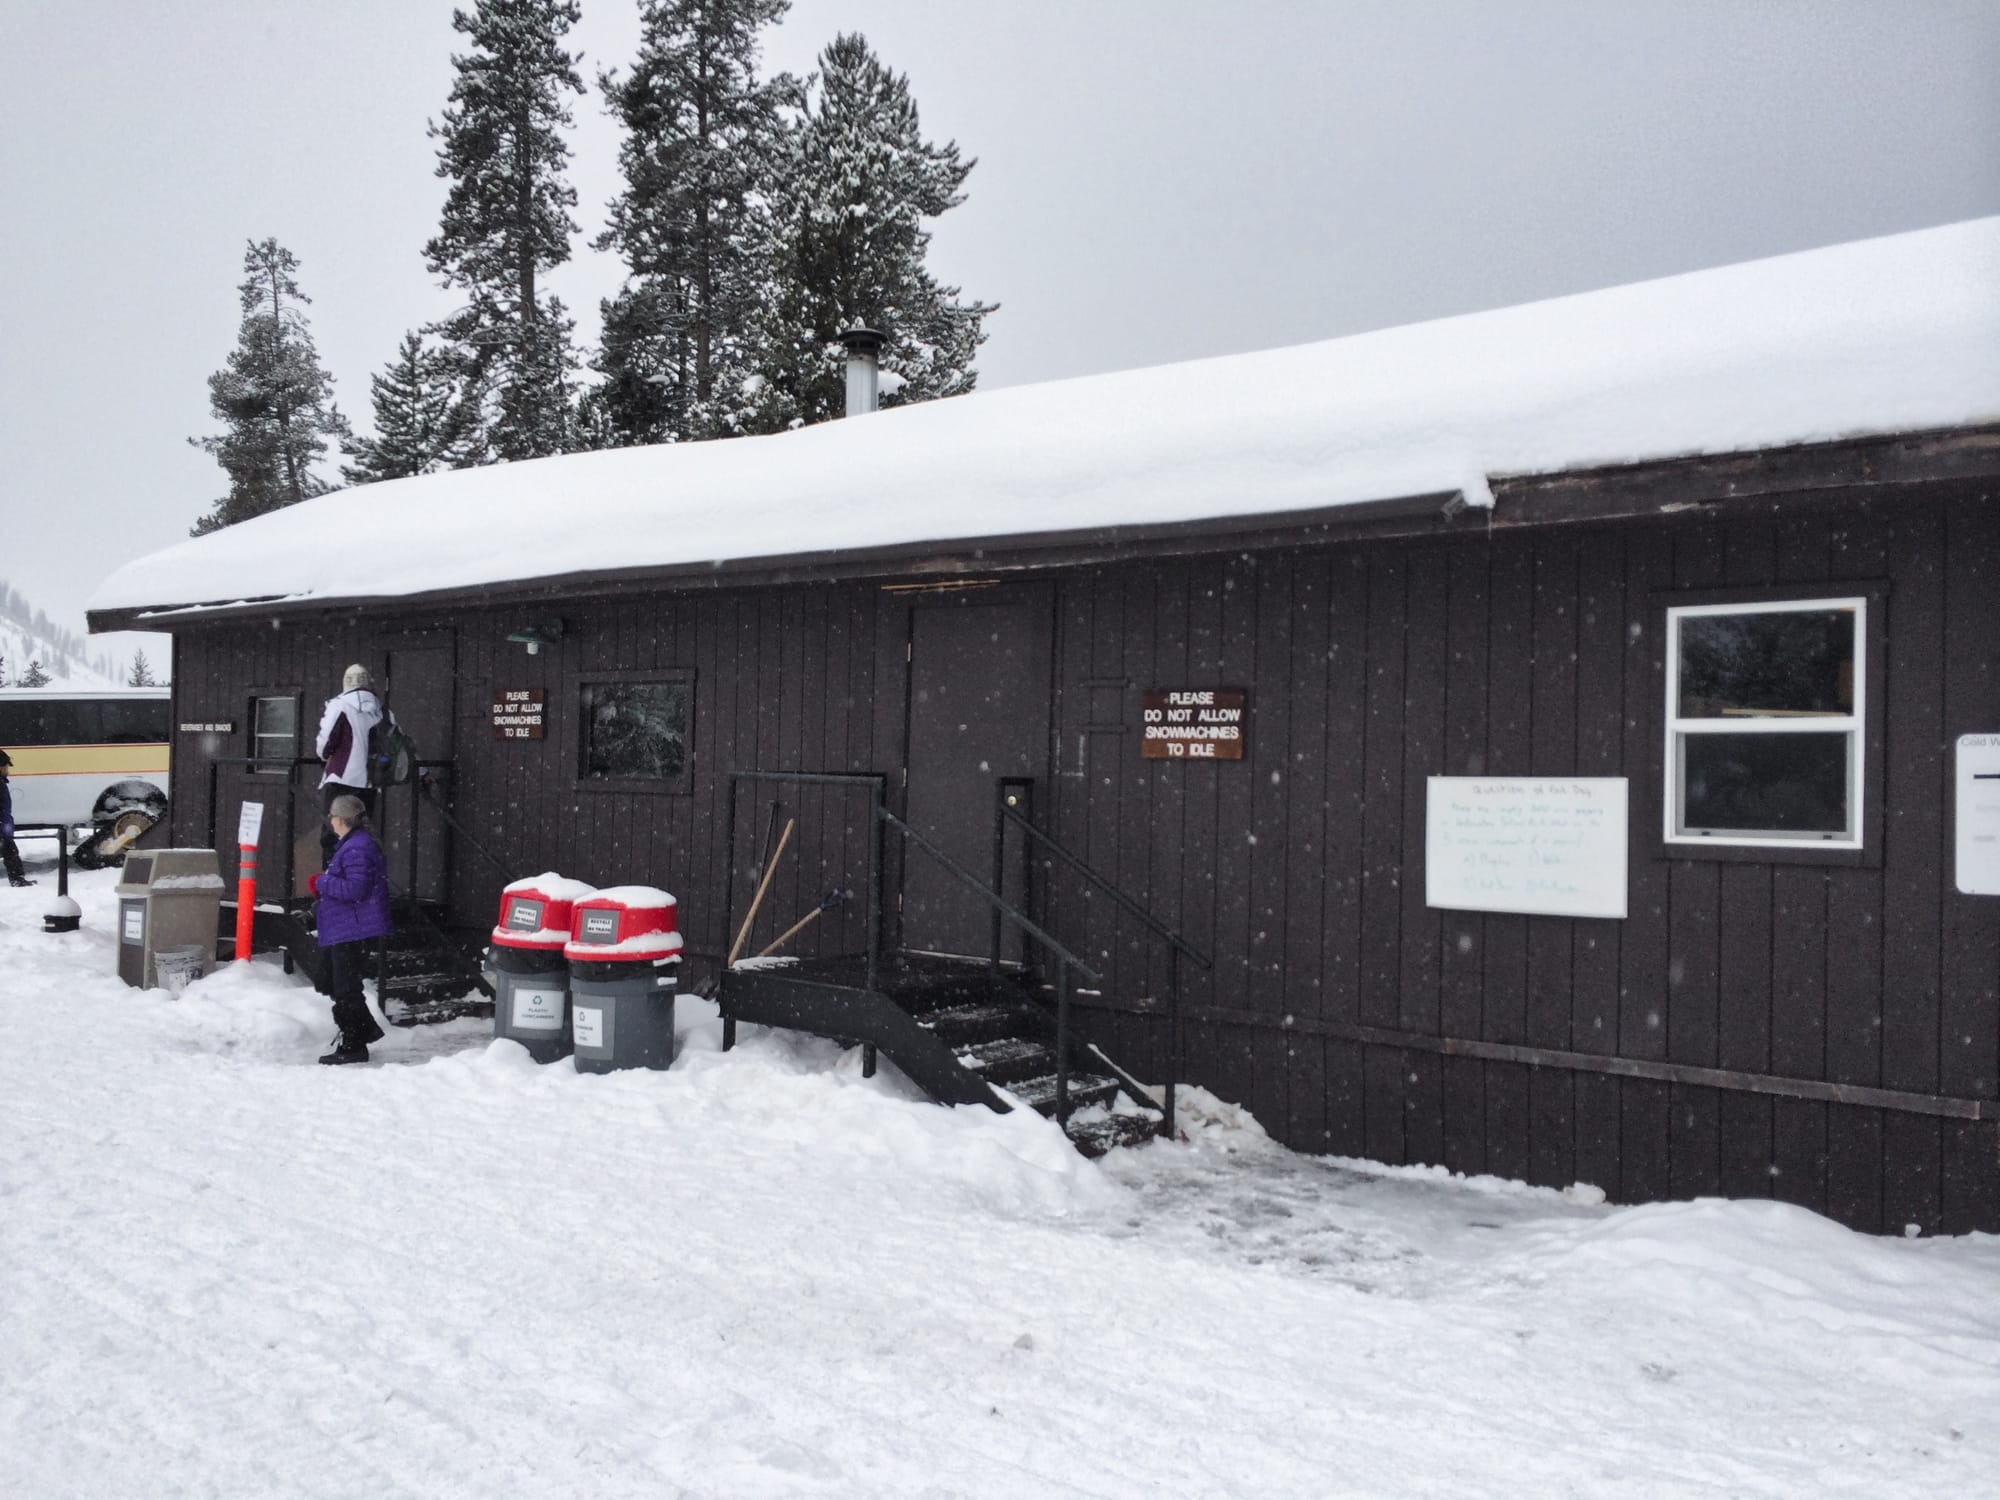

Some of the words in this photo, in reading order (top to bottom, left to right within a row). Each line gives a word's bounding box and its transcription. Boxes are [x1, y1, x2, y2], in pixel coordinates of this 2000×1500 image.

[506, 691, 530, 701] PLEASE
[1169, 691, 1214, 705] PLEASE
[493, 703, 504, 713] DO
[505, 703, 518, 713] NOT
[521, 703, 543, 713] ALLOW
[494, 715, 542, 725] SNOWMACHINES
[1144, 708, 1162, 722] DO
[1167, 708, 1192, 722] NOT
[1198, 708, 1241, 722] ALLOW
[505, 727, 514, 737] TO
[516, 727, 530, 737] IDLE
[1145, 725, 1239, 740] SNOWMACHINES
[1961, 735, 1986, 746] Cold
[1167, 742, 1184, 756] TO
[1189, 743, 1215, 757] IDLE
